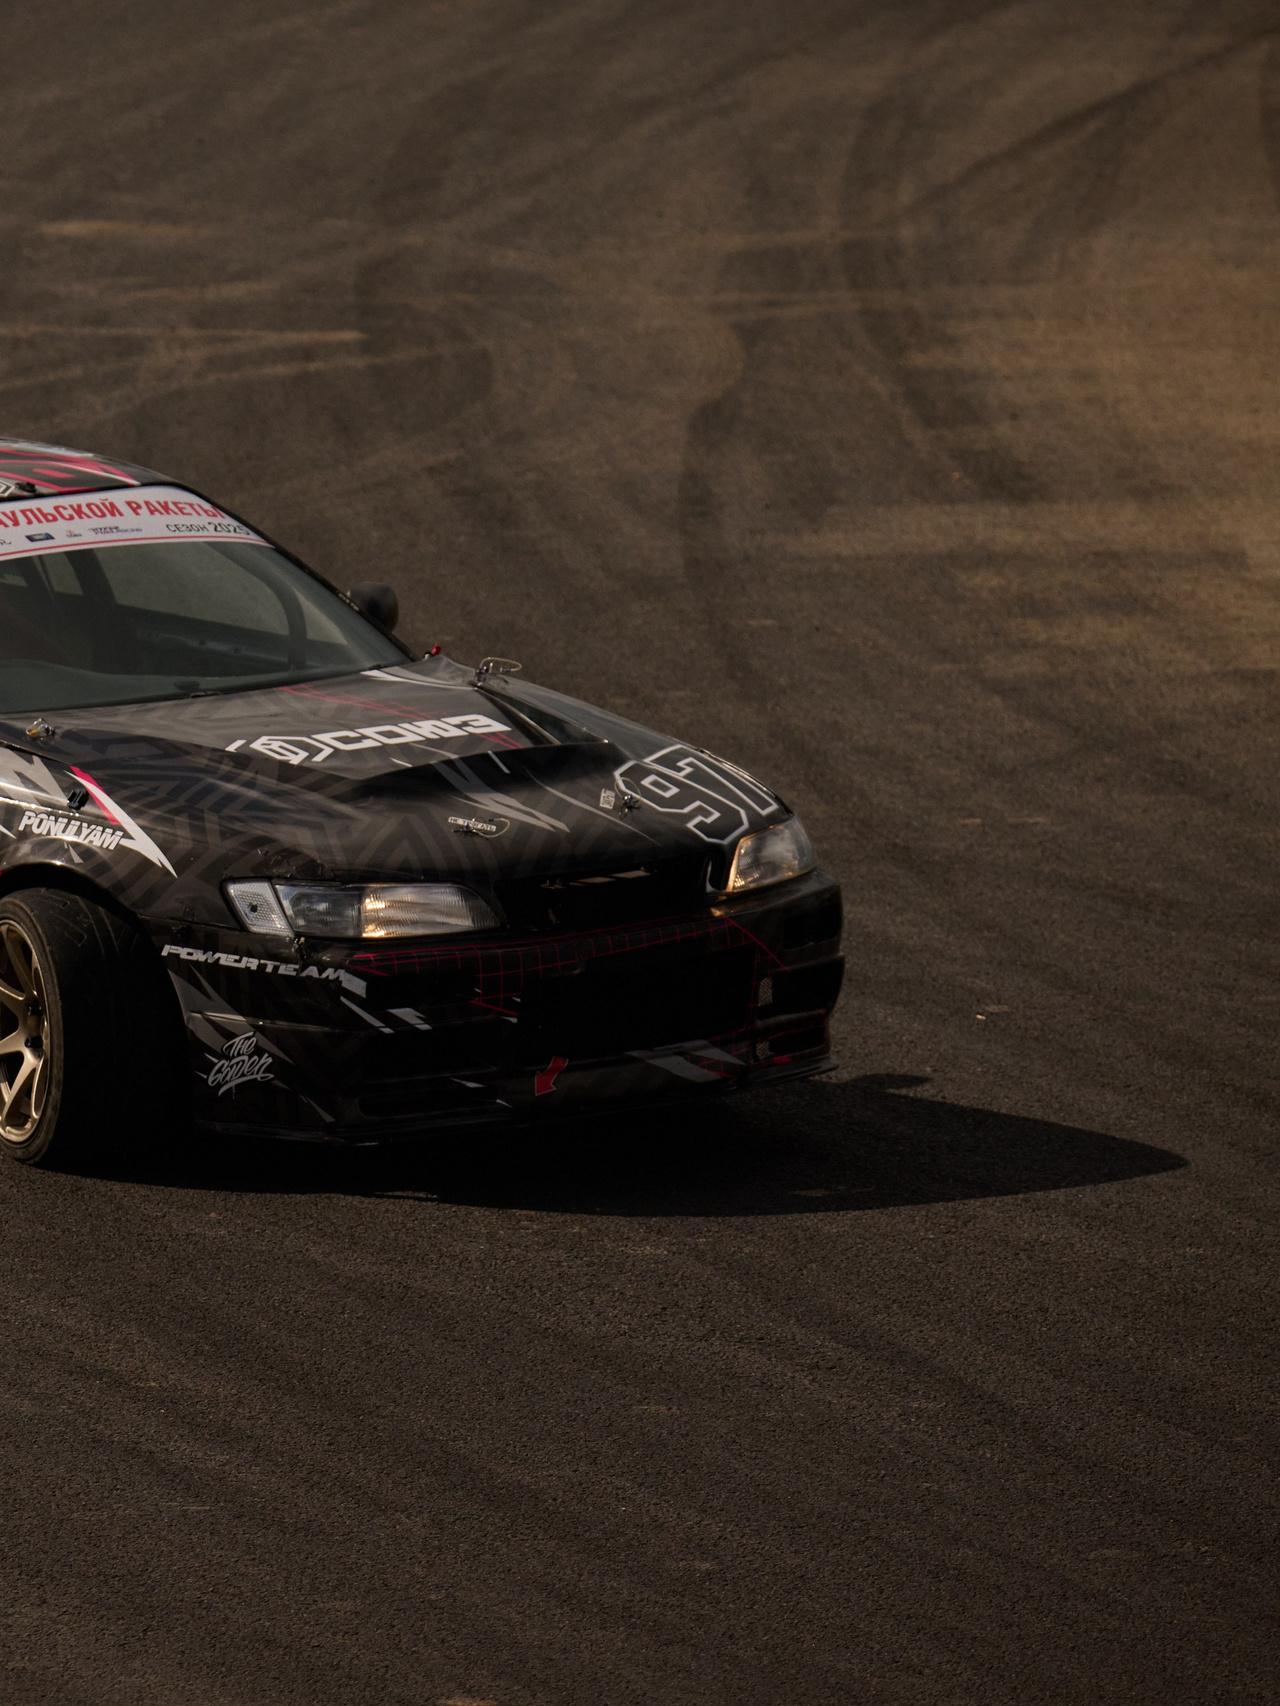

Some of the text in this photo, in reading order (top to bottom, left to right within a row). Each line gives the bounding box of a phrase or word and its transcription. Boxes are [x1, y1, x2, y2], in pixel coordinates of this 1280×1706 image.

[126, 500, 226, 519] РАКЕТЫ
[166, 522, 250, 535] СЕЗОН 2025
[311, 714, 512, 751] СОЮЗ
[613, 744, 779, 846] 97
[18, 811, 124, 850] PONULYAM
